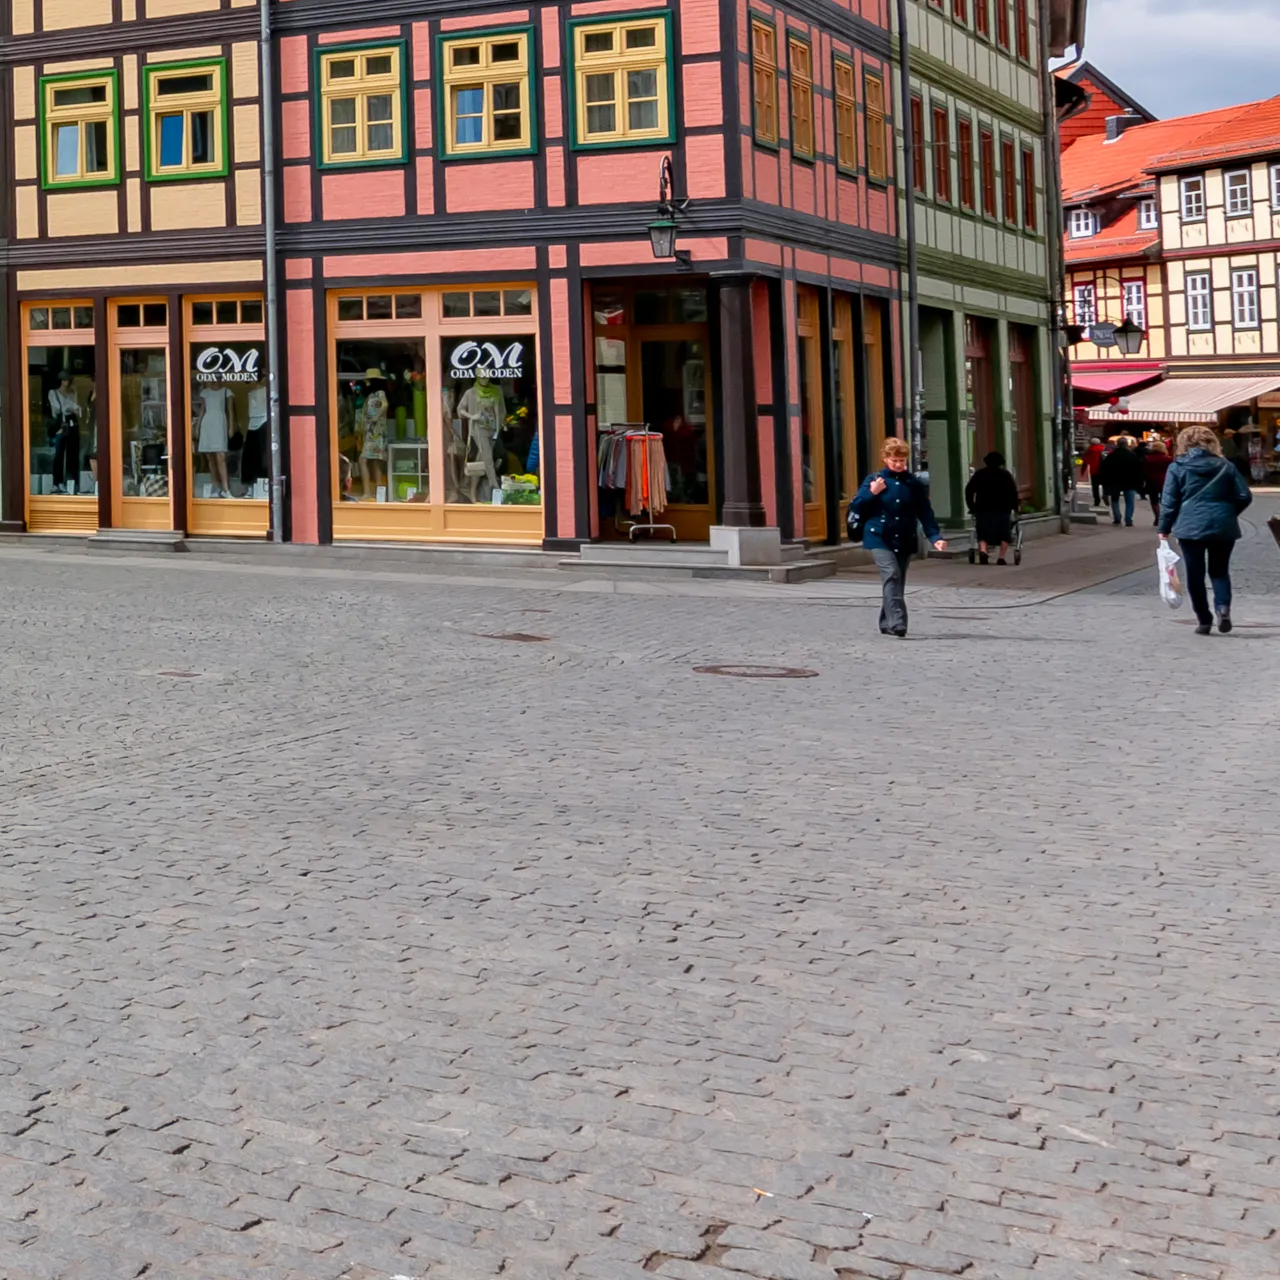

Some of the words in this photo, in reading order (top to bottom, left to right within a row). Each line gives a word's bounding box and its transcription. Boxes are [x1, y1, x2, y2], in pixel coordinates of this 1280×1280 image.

[196, 347, 259, 373] OM
[451, 341, 523, 369] OM
[196, 373, 218, 382] ODA
[221, 372, 259, 382] MODEN
[450, 369, 475, 379] ODA
[479, 368, 523, 378] MODEN
